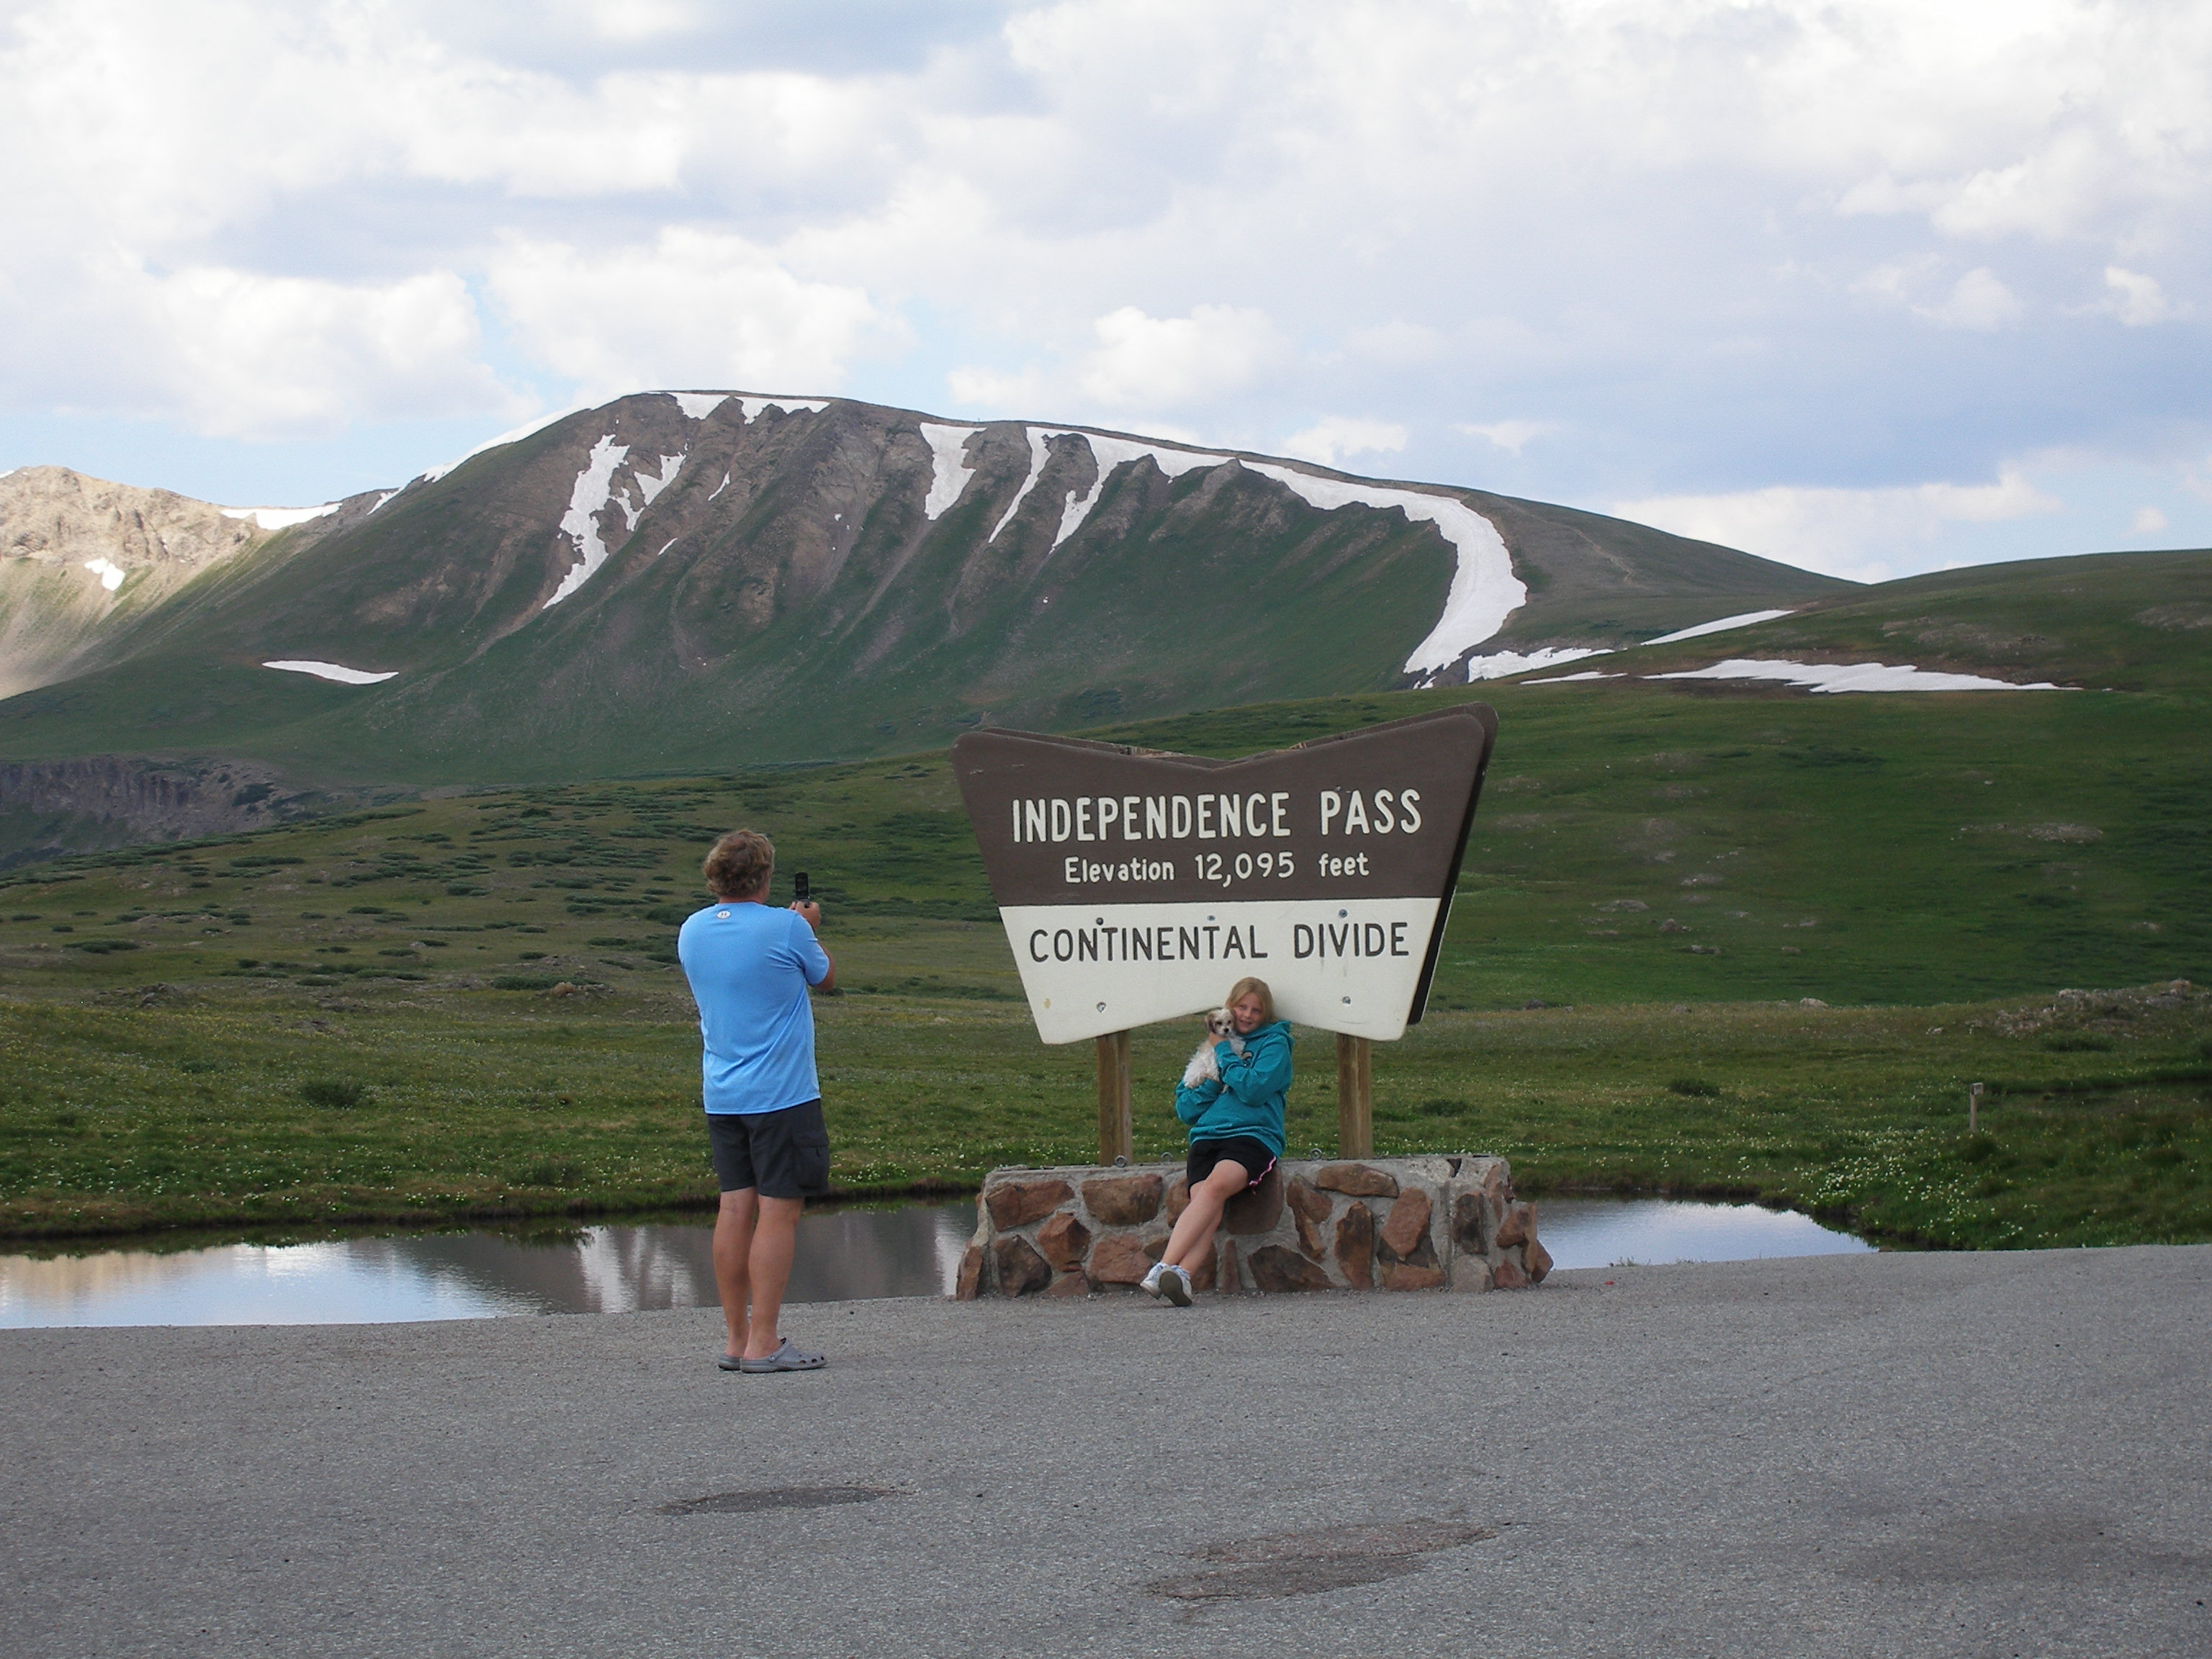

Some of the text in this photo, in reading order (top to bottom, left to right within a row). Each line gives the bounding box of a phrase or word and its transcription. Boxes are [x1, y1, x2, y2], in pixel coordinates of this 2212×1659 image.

[1012, 788, 1422, 843] INDEPENDENCE PASS
[1064, 851, 1370, 887] Elevation 12,095 feet
[1030, 922, 1410, 962] CONTINENTAL DIVIDE
